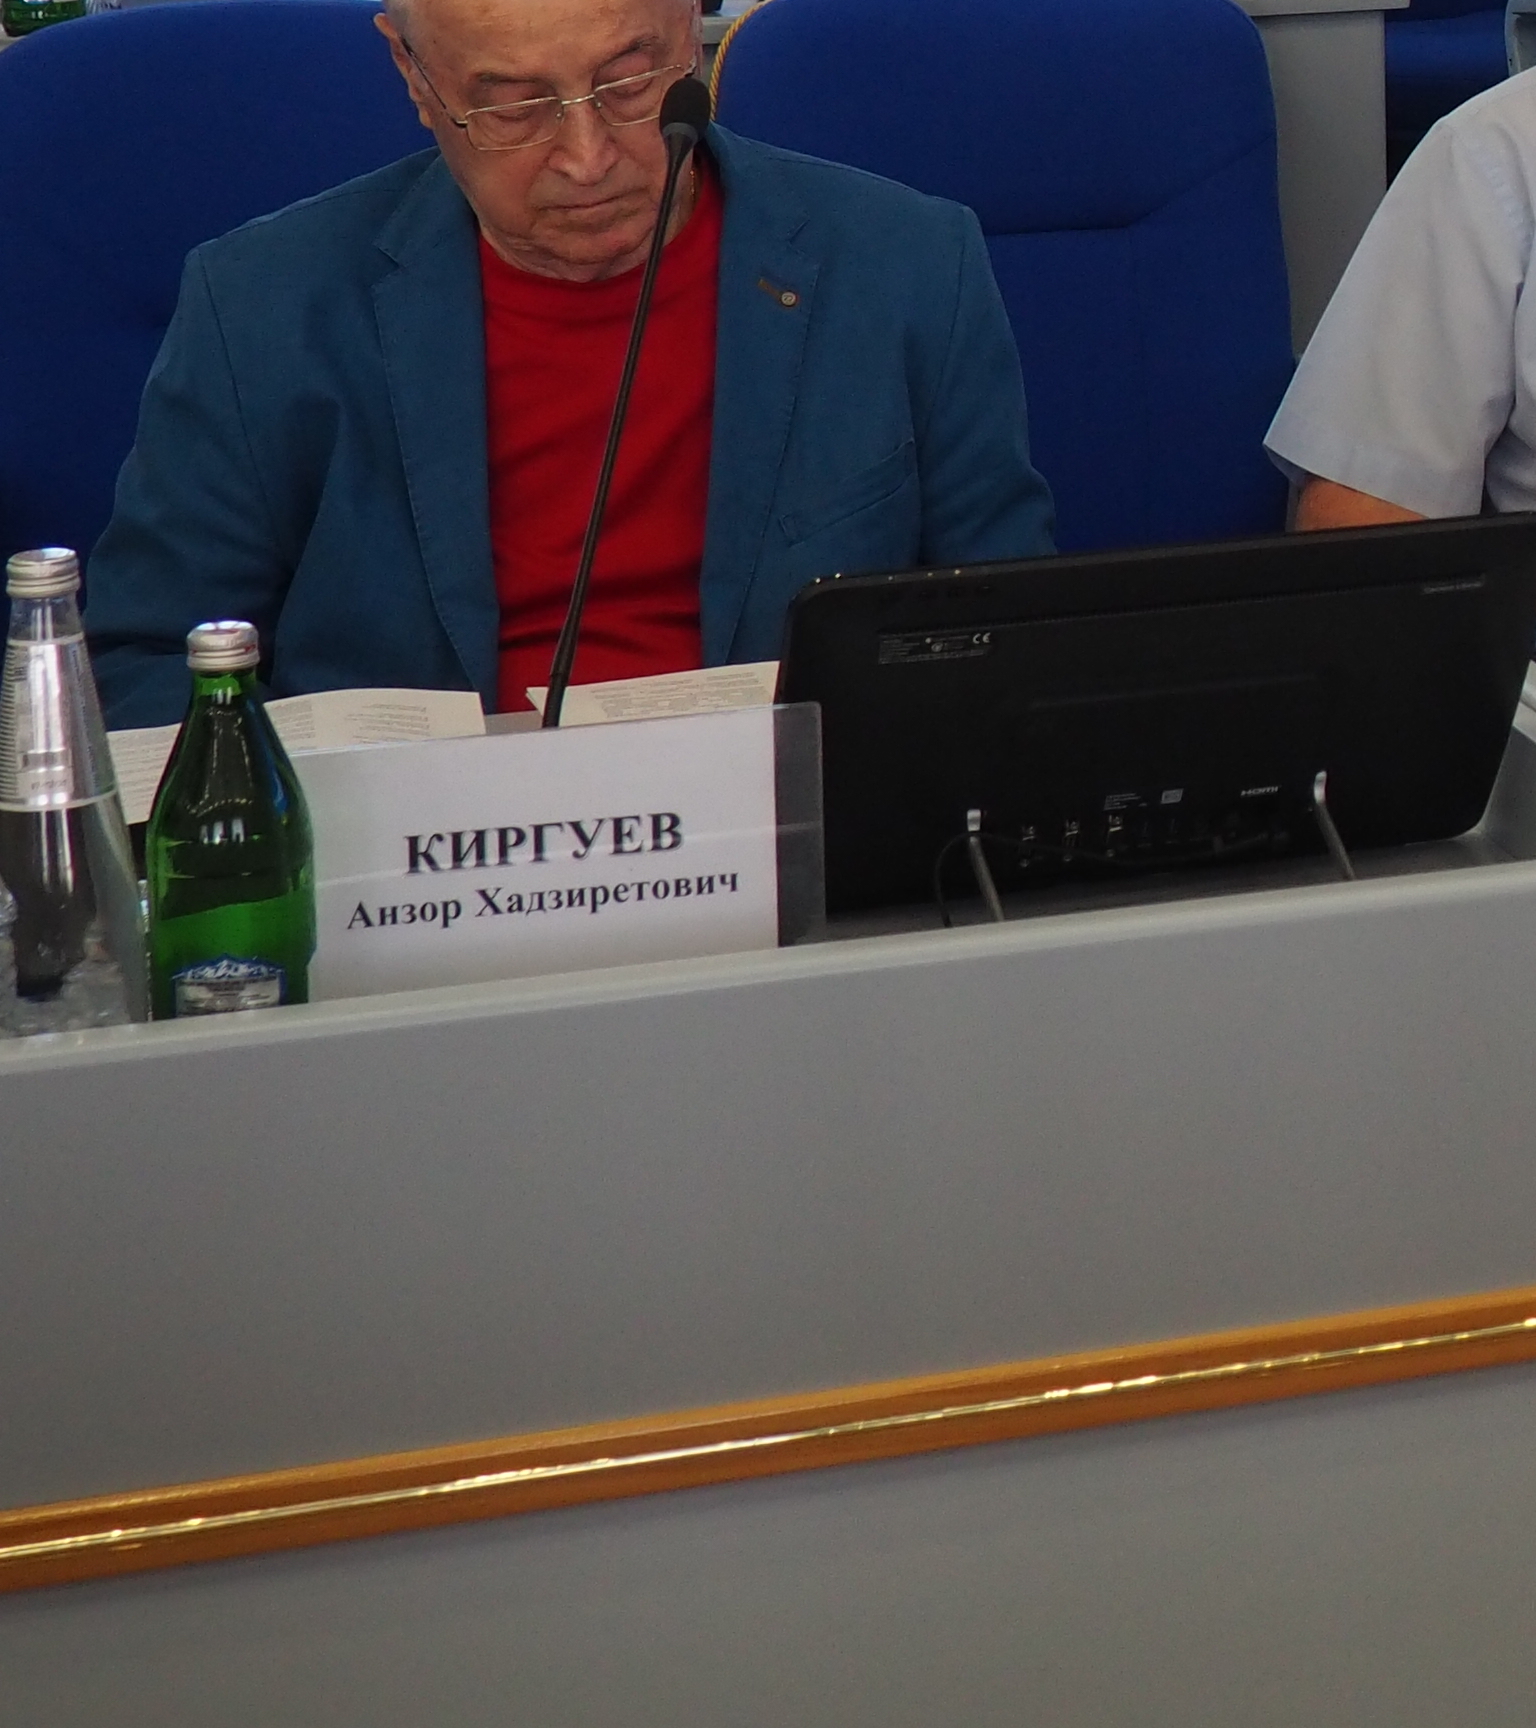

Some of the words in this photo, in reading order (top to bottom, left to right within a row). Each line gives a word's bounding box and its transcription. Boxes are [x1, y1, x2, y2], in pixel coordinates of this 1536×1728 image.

[402, 812, 685, 876] КИРГУЕВ
[346, 897, 463, 930] Анзор
[474, 871, 741, 918] Хадзиретович
